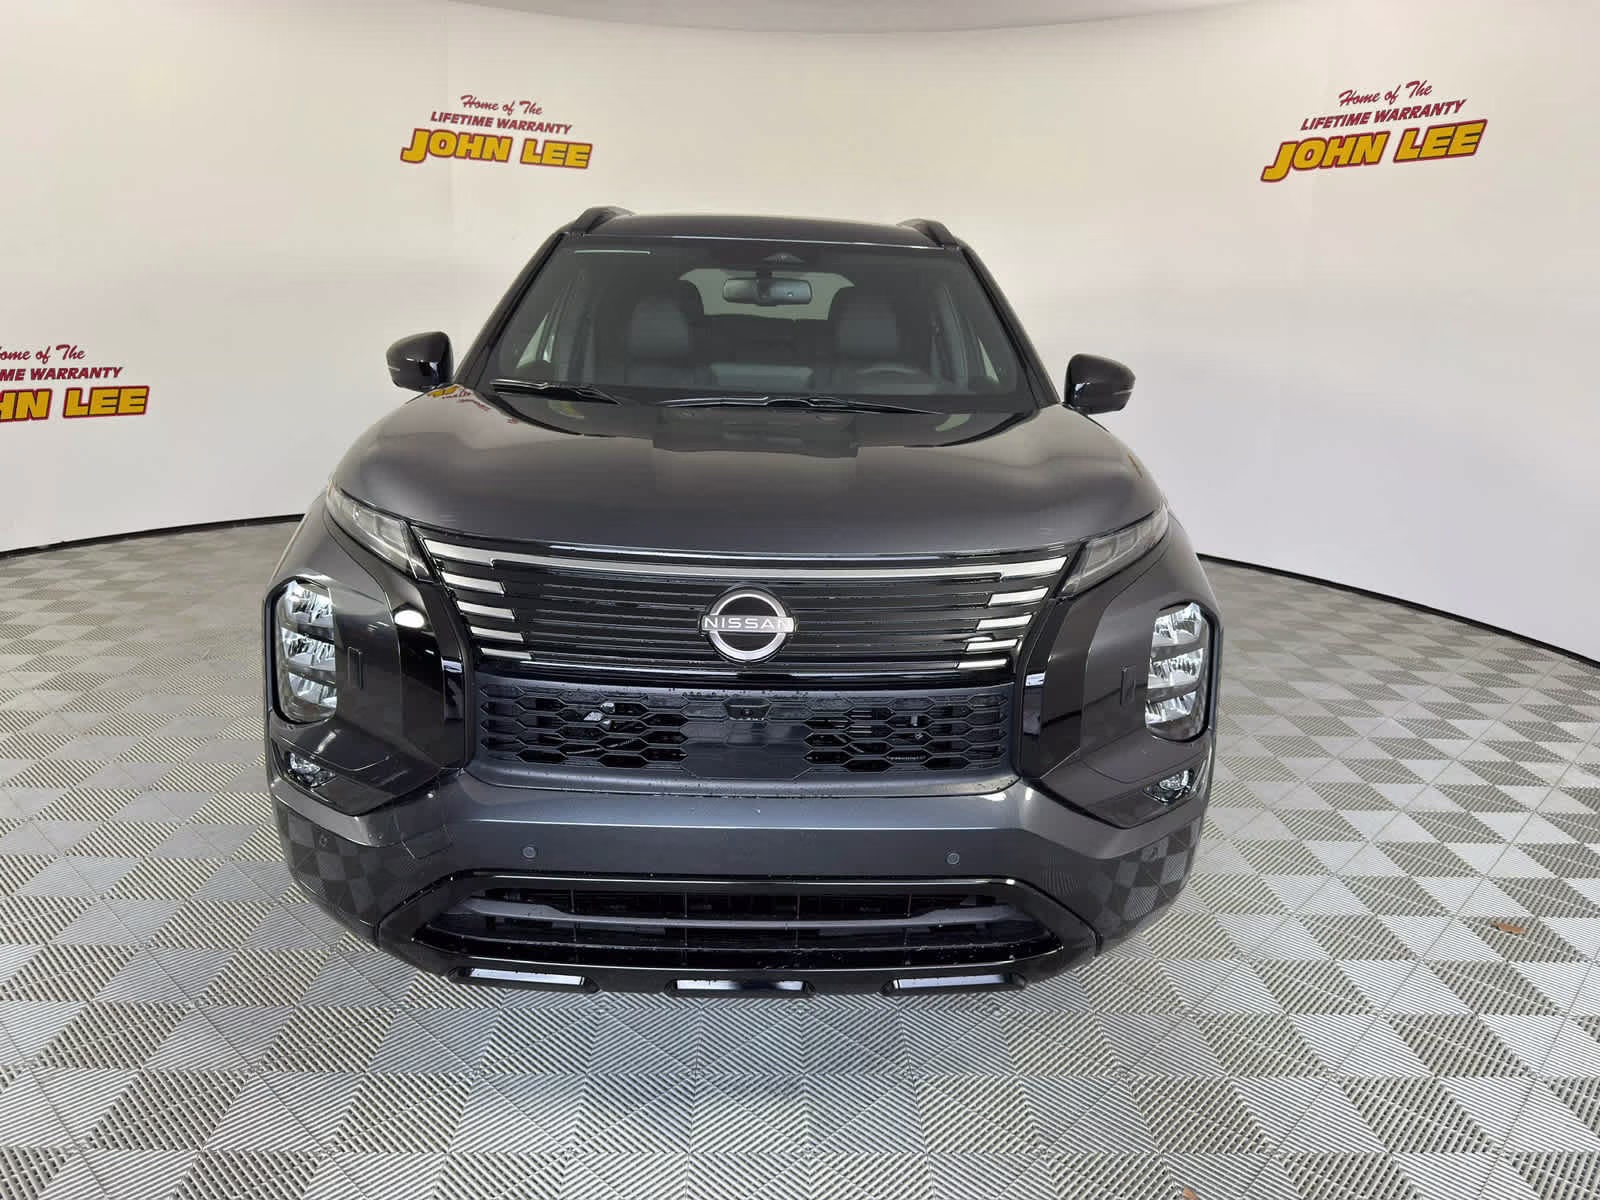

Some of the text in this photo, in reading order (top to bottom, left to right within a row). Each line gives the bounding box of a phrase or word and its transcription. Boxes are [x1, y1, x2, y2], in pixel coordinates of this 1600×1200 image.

[461, 94, 543, 115] Home of The
[1338, 80, 1433, 107] Home of The
[430, 111, 572, 135] LIFETIME WARRANTY
[1300, 99, 1467, 131] LIFETIME WARRANTY
[400, 128, 593, 169] JOHN LEE
[1260, 119, 1488, 183] JOHN LEE
[0, 344, 86, 365] ome of The
[30, 367, 124, 381] WARRANTY
[62, 385, 149, 418] LEE
[704, 616, 789, 630] NISSAN
